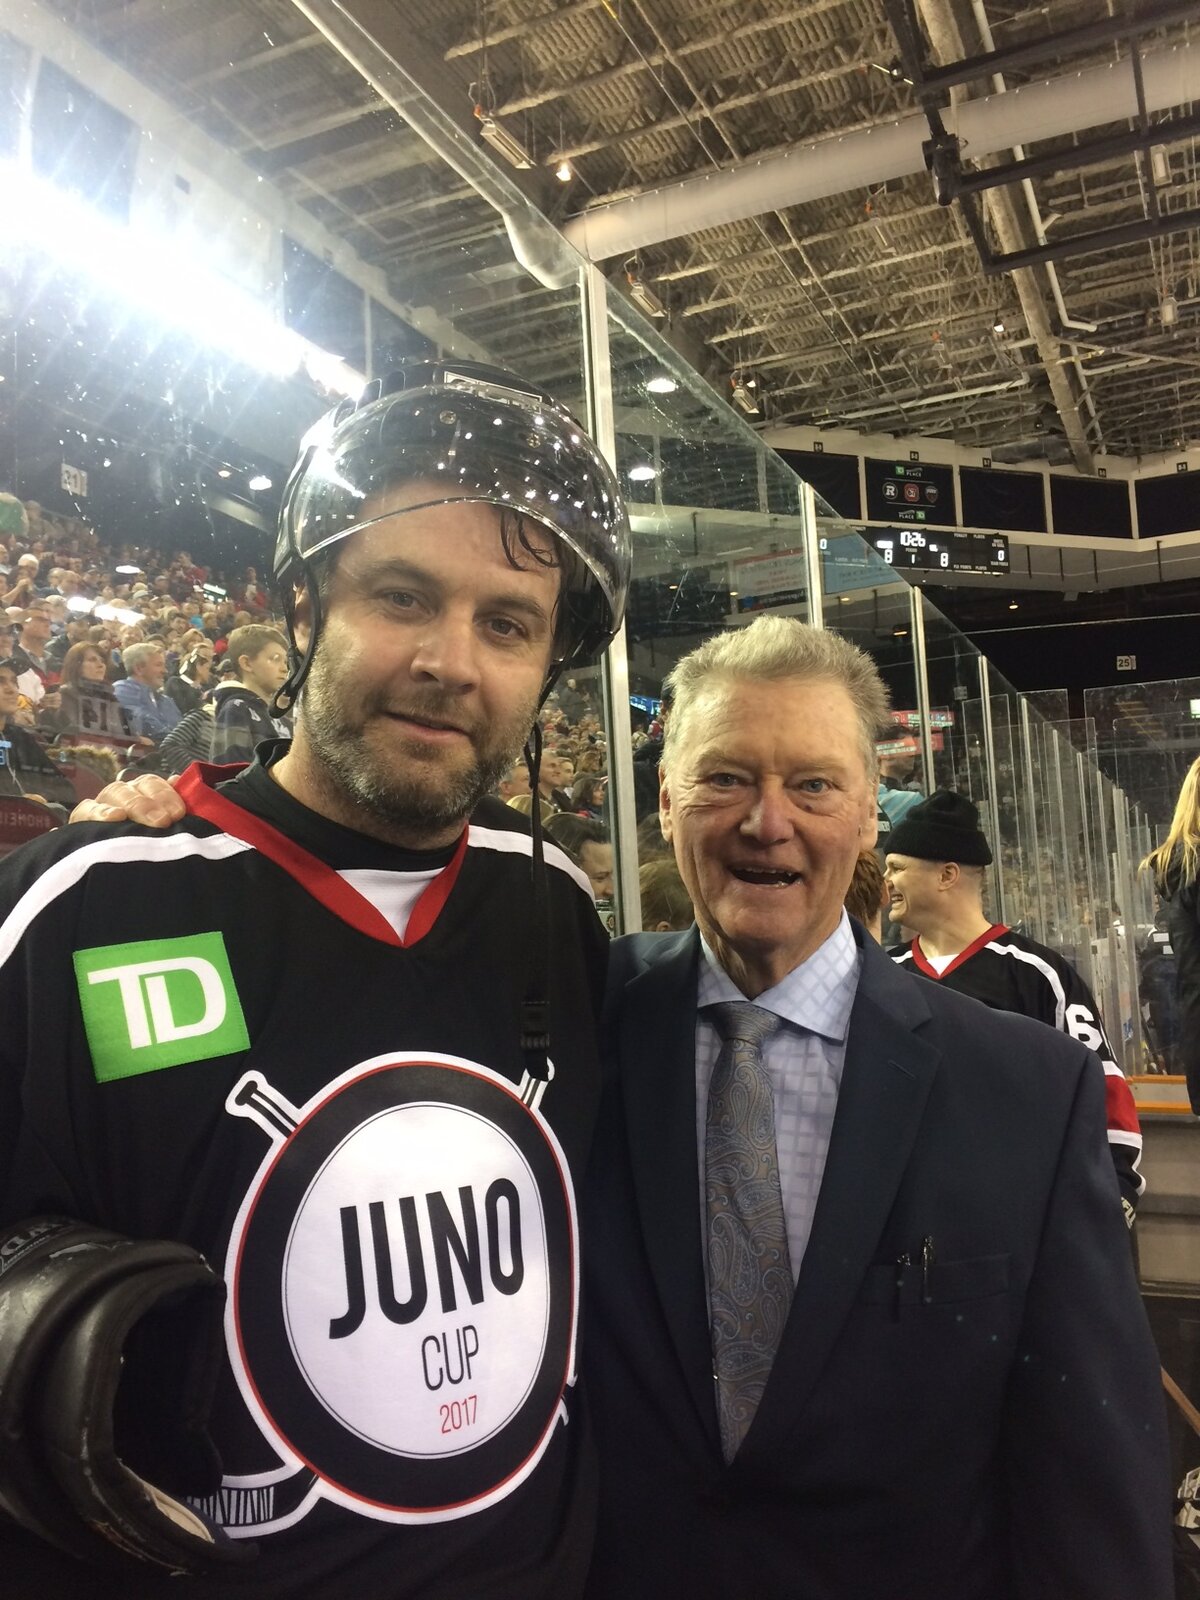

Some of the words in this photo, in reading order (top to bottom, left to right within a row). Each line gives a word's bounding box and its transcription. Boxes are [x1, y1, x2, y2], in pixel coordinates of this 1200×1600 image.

[940, 552, 949, 568] 8
[1118, 658, 1130, 668] 25
[87, 956, 227, 1050] TD
[1065, 1003, 1103, 1051] 6
[329, 1178, 524, 1339] JUNO
[421, 1325, 479, 1391] CUP
[439, 1395, 477, 1434] 2017
